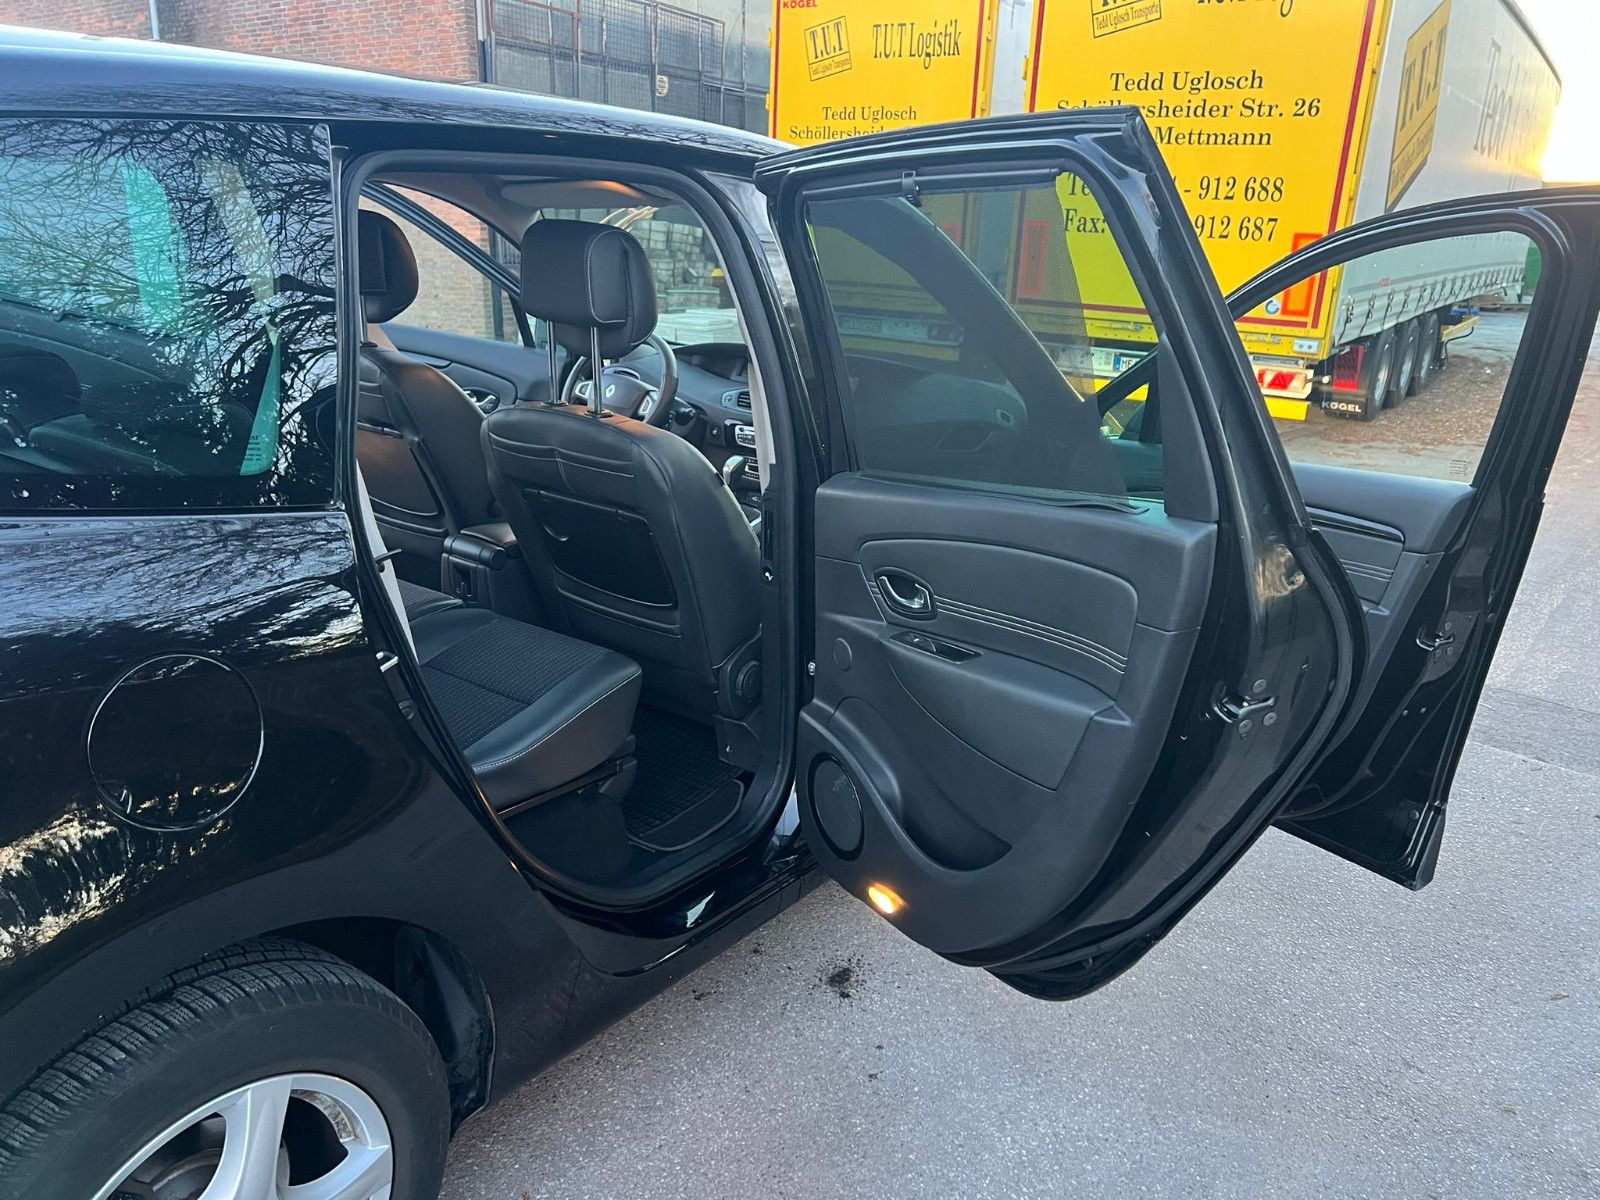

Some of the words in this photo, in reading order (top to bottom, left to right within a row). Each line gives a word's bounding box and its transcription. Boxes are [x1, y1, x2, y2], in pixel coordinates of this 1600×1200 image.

[909, 18, 962, 70] Logistik
[1110, 72, 1164, 92] Tedd
[1172, 69, 1264, 95] Uglosch
[822, 106, 856, 121] Tedd
[861, 105, 918, 123] Uglosch
[1240, 97, 1284, 118] Str.
[1293, 97, 1321, 118] 26
[1155, 126, 1273, 146] Mettmann
[1198, 175, 1237, 201] 912
[1244, 176, 1284, 202] 688
[1065, 208, 1105, 234] Fax:
[1194, 214, 1231, 240] 912
[1238, 216, 1279, 242] 687
